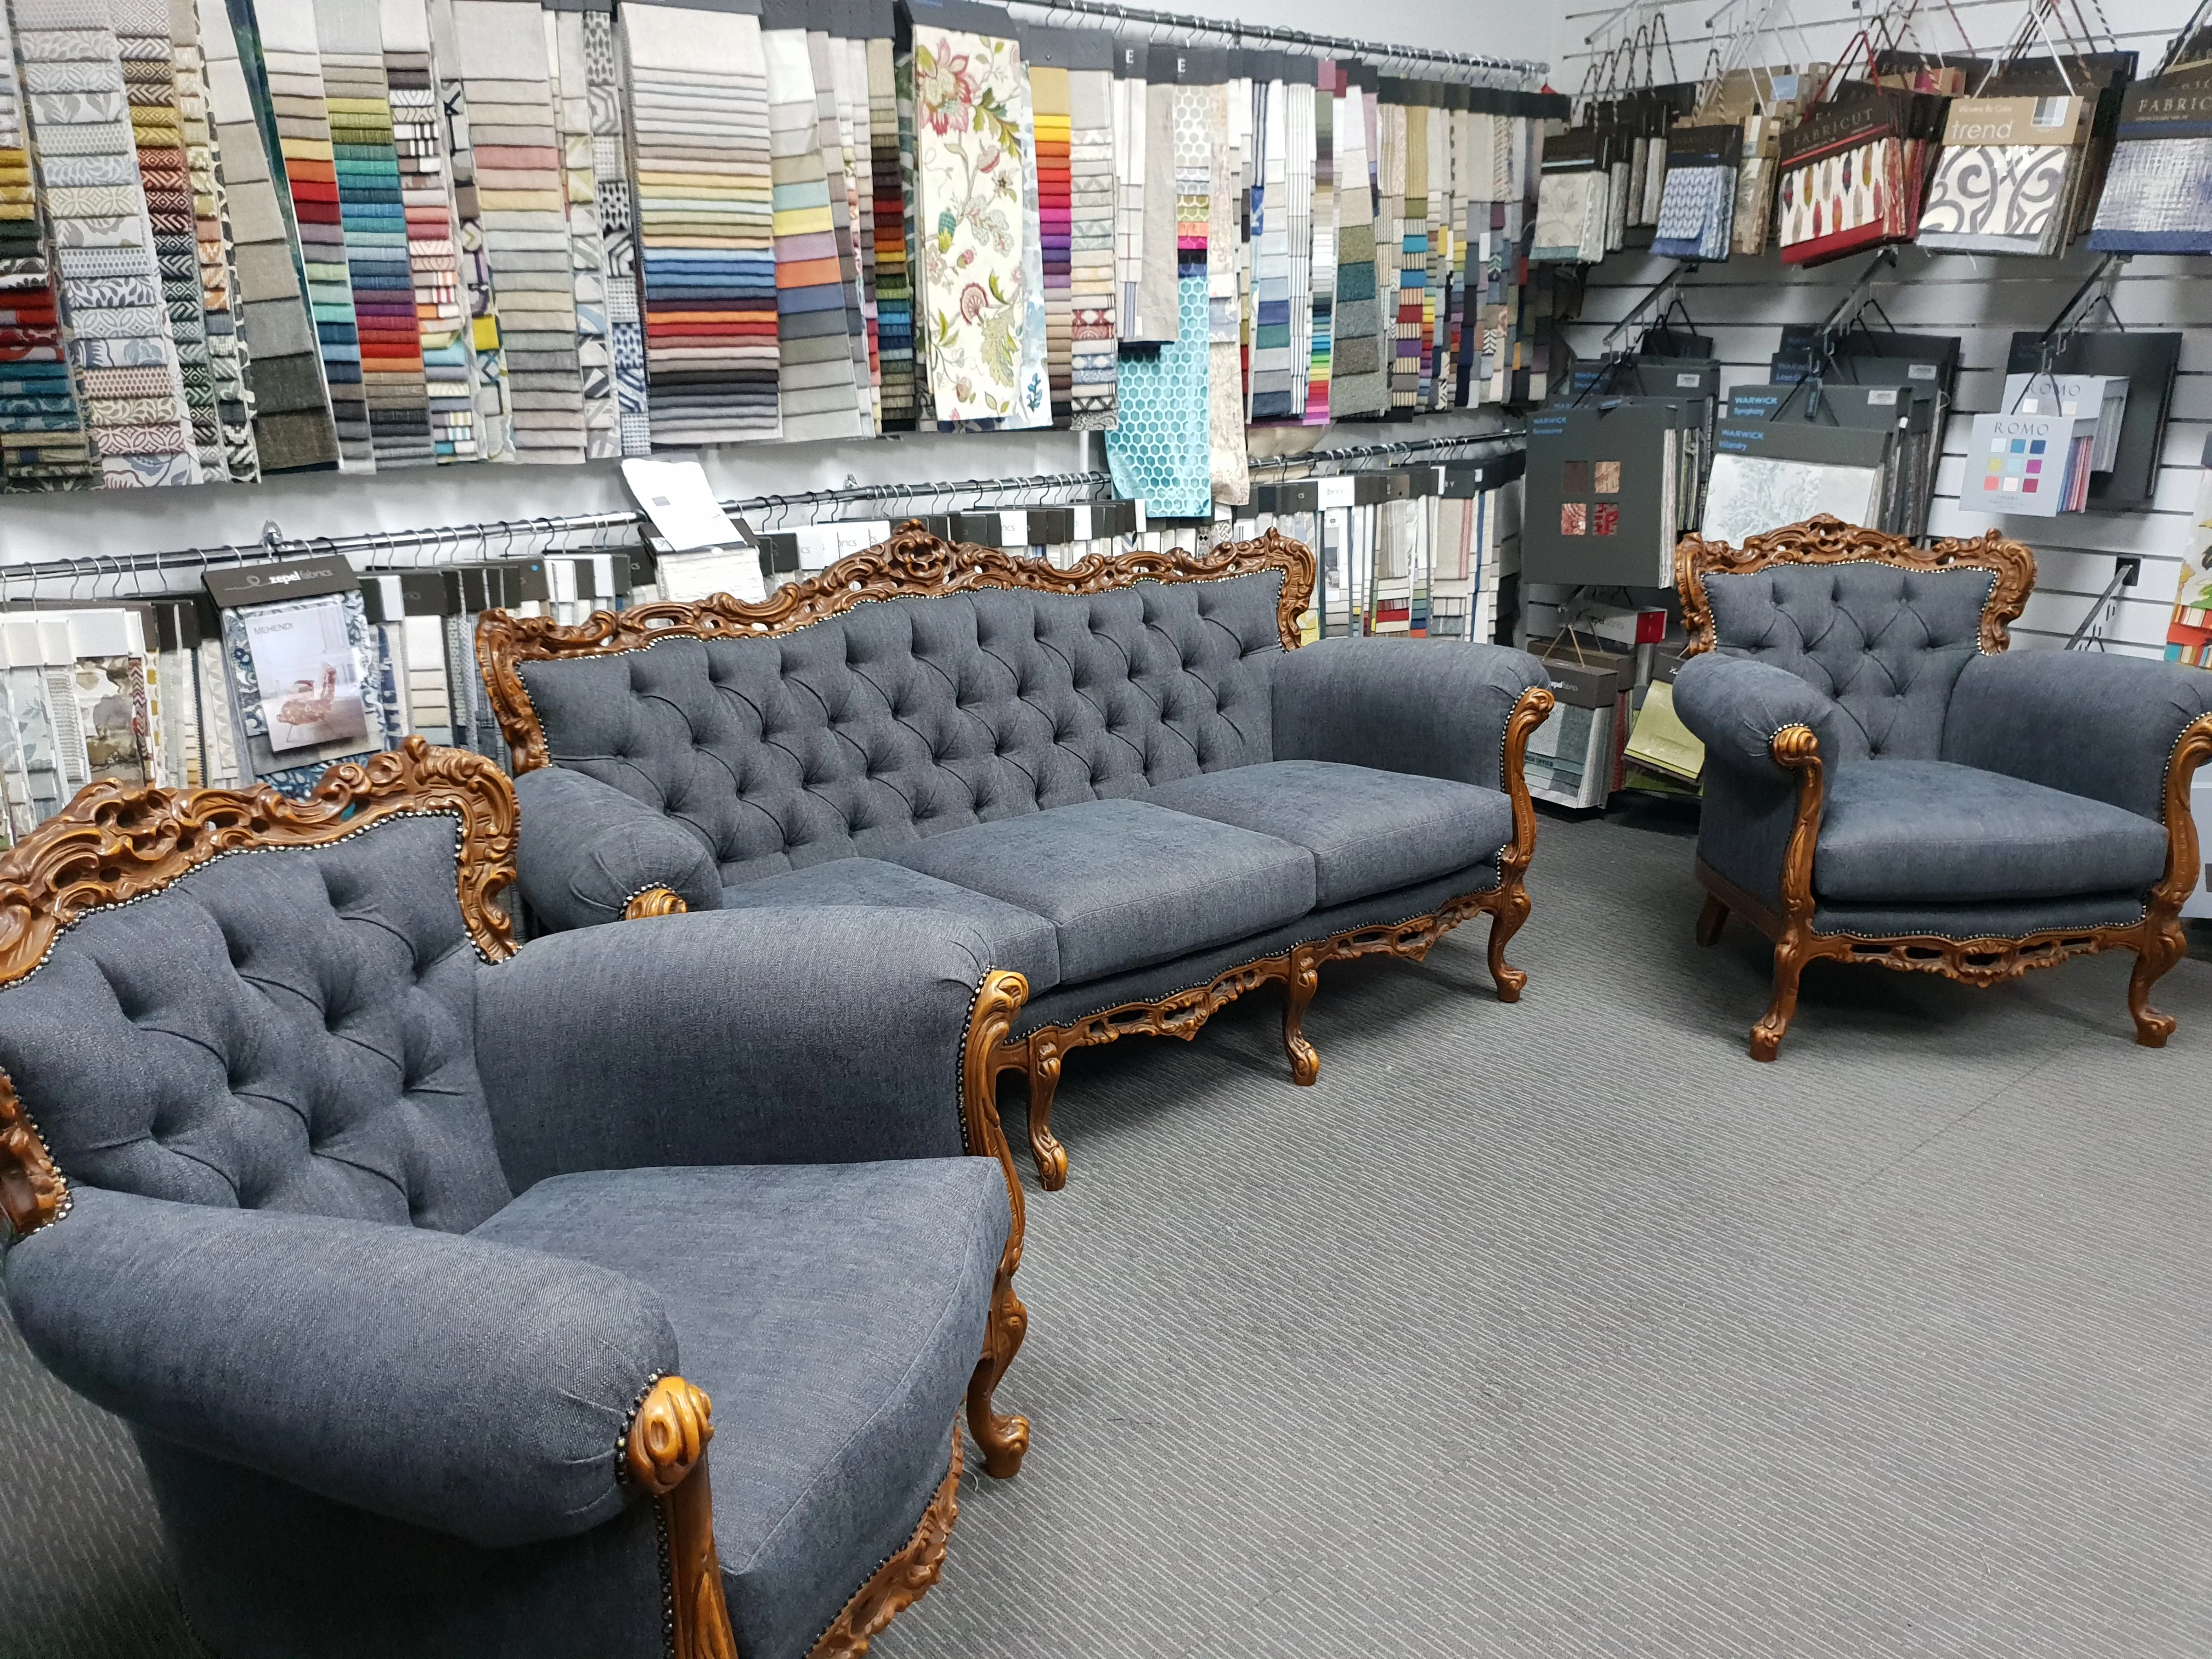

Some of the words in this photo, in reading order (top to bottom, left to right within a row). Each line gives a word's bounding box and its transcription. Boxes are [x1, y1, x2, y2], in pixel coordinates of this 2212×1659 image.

[1792, 108, 1873, 149] FABRICUT
[1952, 119, 2013, 139] trend
[1722, 430, 1763, 439] WARWICK
[1994, 421, 2049, 436] ROMO
[254, 623, 293, 634] MEHENDI
